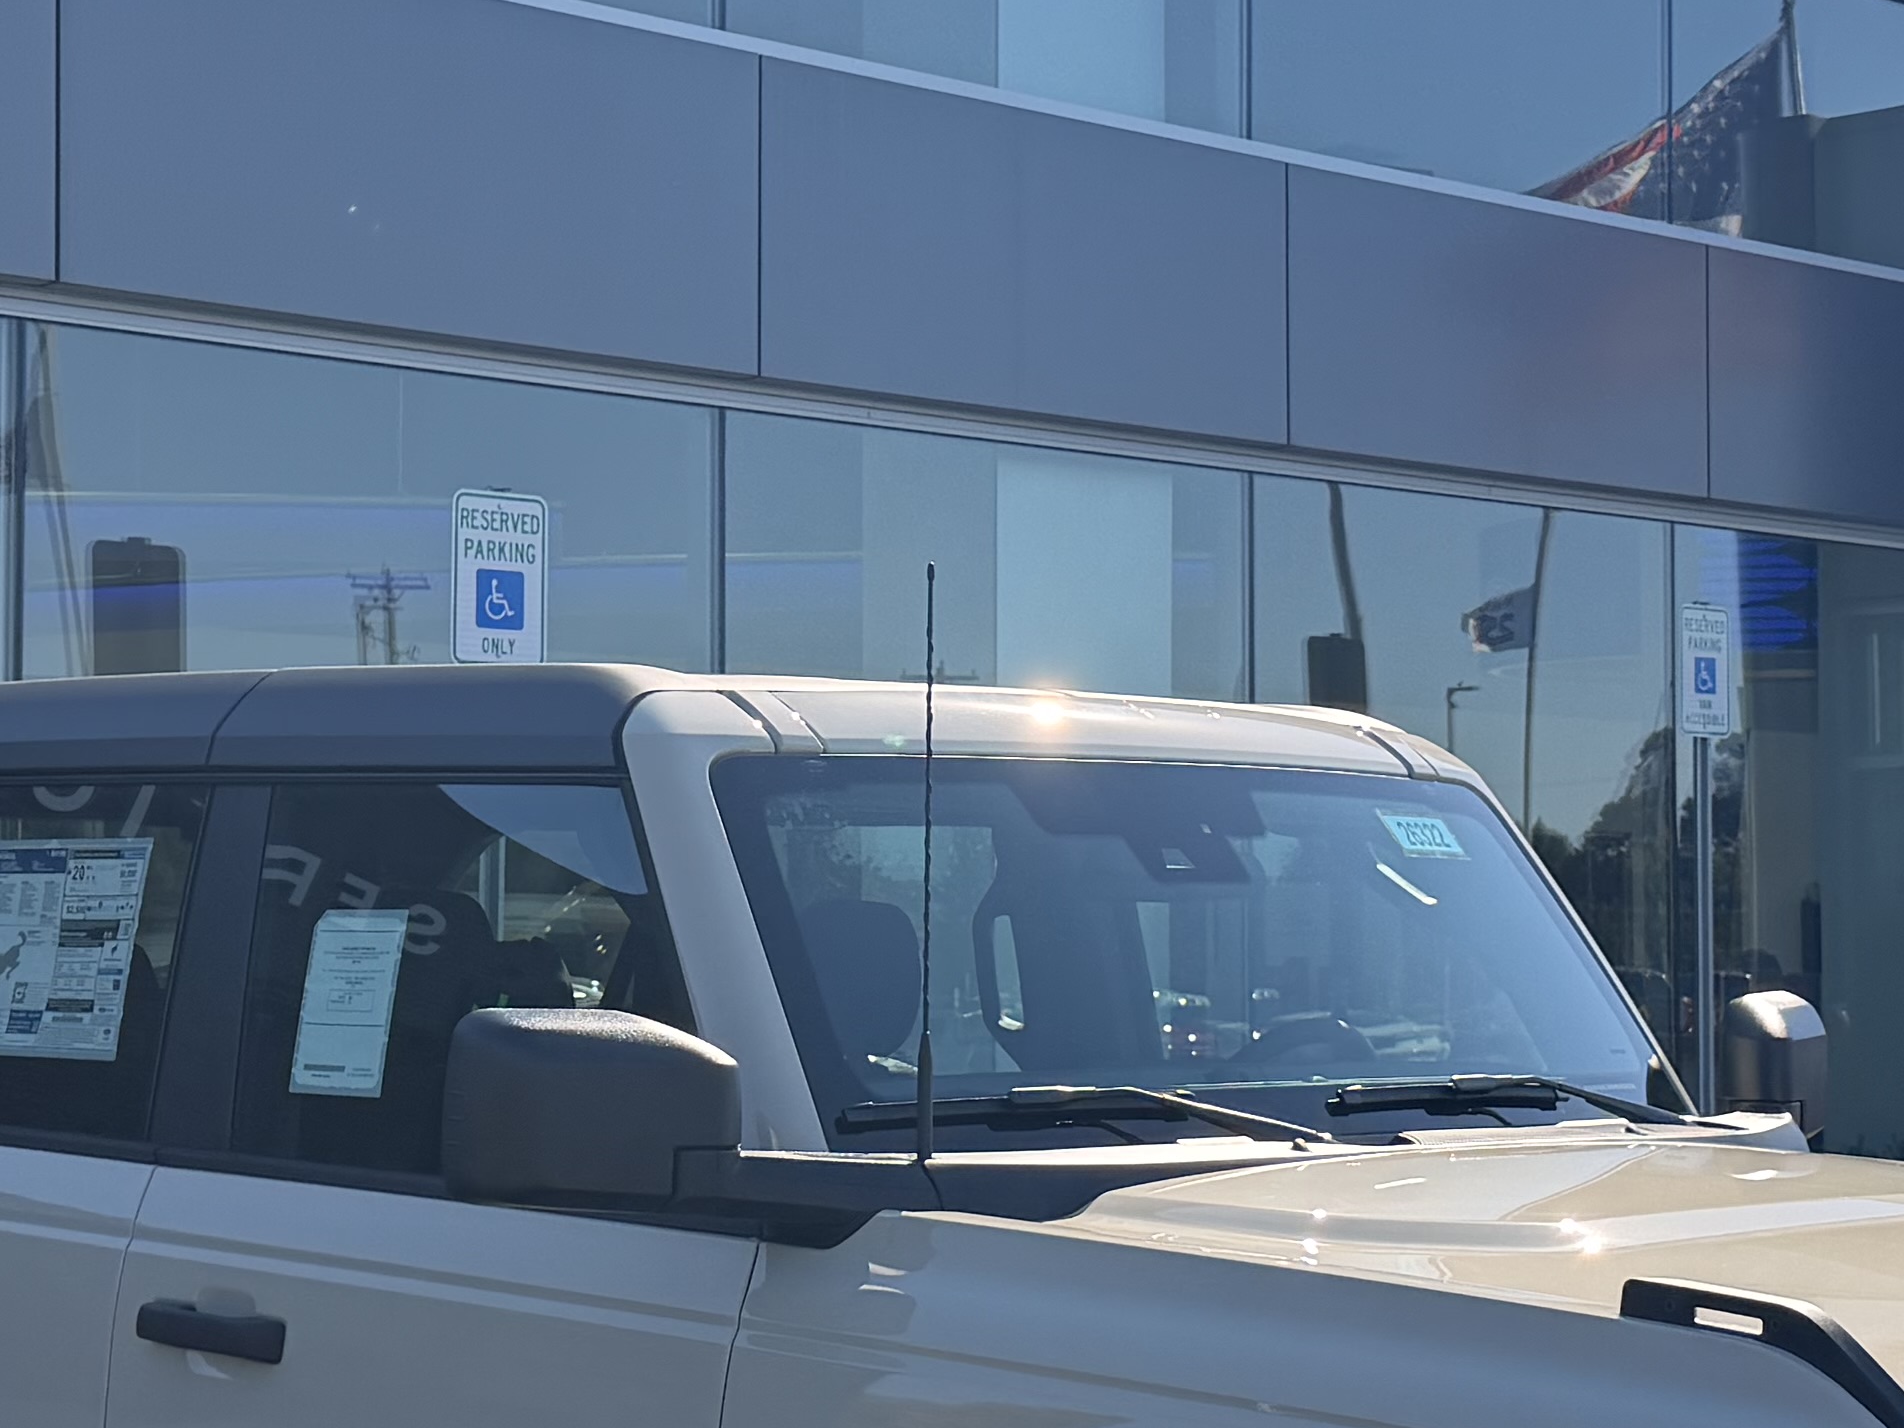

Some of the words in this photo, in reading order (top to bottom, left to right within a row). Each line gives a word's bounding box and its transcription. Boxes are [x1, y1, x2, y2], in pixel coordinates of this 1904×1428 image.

[460, 507, 541, 535] RESERVED
[464, 538, 536, 565] PARKING
[481, 637, 516, 655] ONLY
[1396, 821, 1451, 848] 26322
